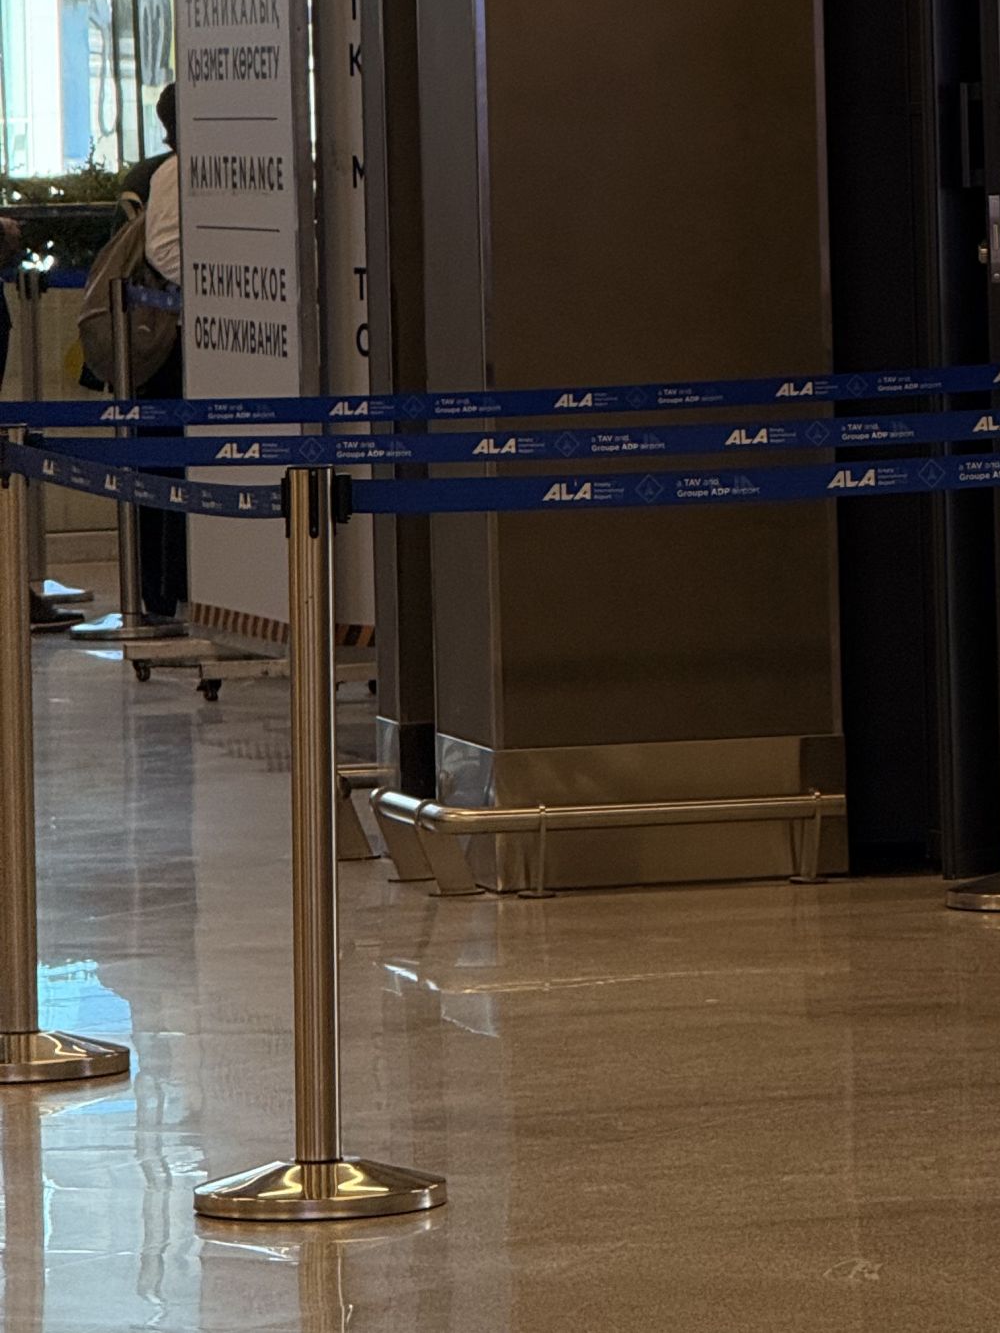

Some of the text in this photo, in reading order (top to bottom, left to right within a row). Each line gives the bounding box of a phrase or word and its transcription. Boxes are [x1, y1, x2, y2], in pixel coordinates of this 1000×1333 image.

[187, 45, 280, 88] ҚЫЗМЕТ КӨРСЕТУ
[190, 155, 285, 191] MAINTENANCE
[193, 263, 286, 302] ТЕХНИЧЕСКОЕ
[195, 316, 288, 359] ОБСЛУЖИВАНИЕ
[775, 381, 813, 397] ALA
[553, 392, 593, 408] ALA
[100, 405, 140, 420] ALA
[328, 401, 368, 416] ALA
[724, 428, 768, 446] ALA
[841, 433, 870, 441] Groupe
[889, 430, 915, 439] airport
[215, 442, 262, 459] ALA
[343, 441, 359, 449] TAV
[472, 437, 517, 454] ALA
[591, 444, 620, 453] Groupe
[640, 442, 665, 451] airport
[336, 449, 412, 459] Groupe ADP airport
[683, 478, 701, 486] TAV
[827, 469, 877, 489] ALA
[959, 473, 990, 481] Groupe
[542, 482, 592, 501] ALA
[677, 486, 760, 498] Groupe ADP airport
